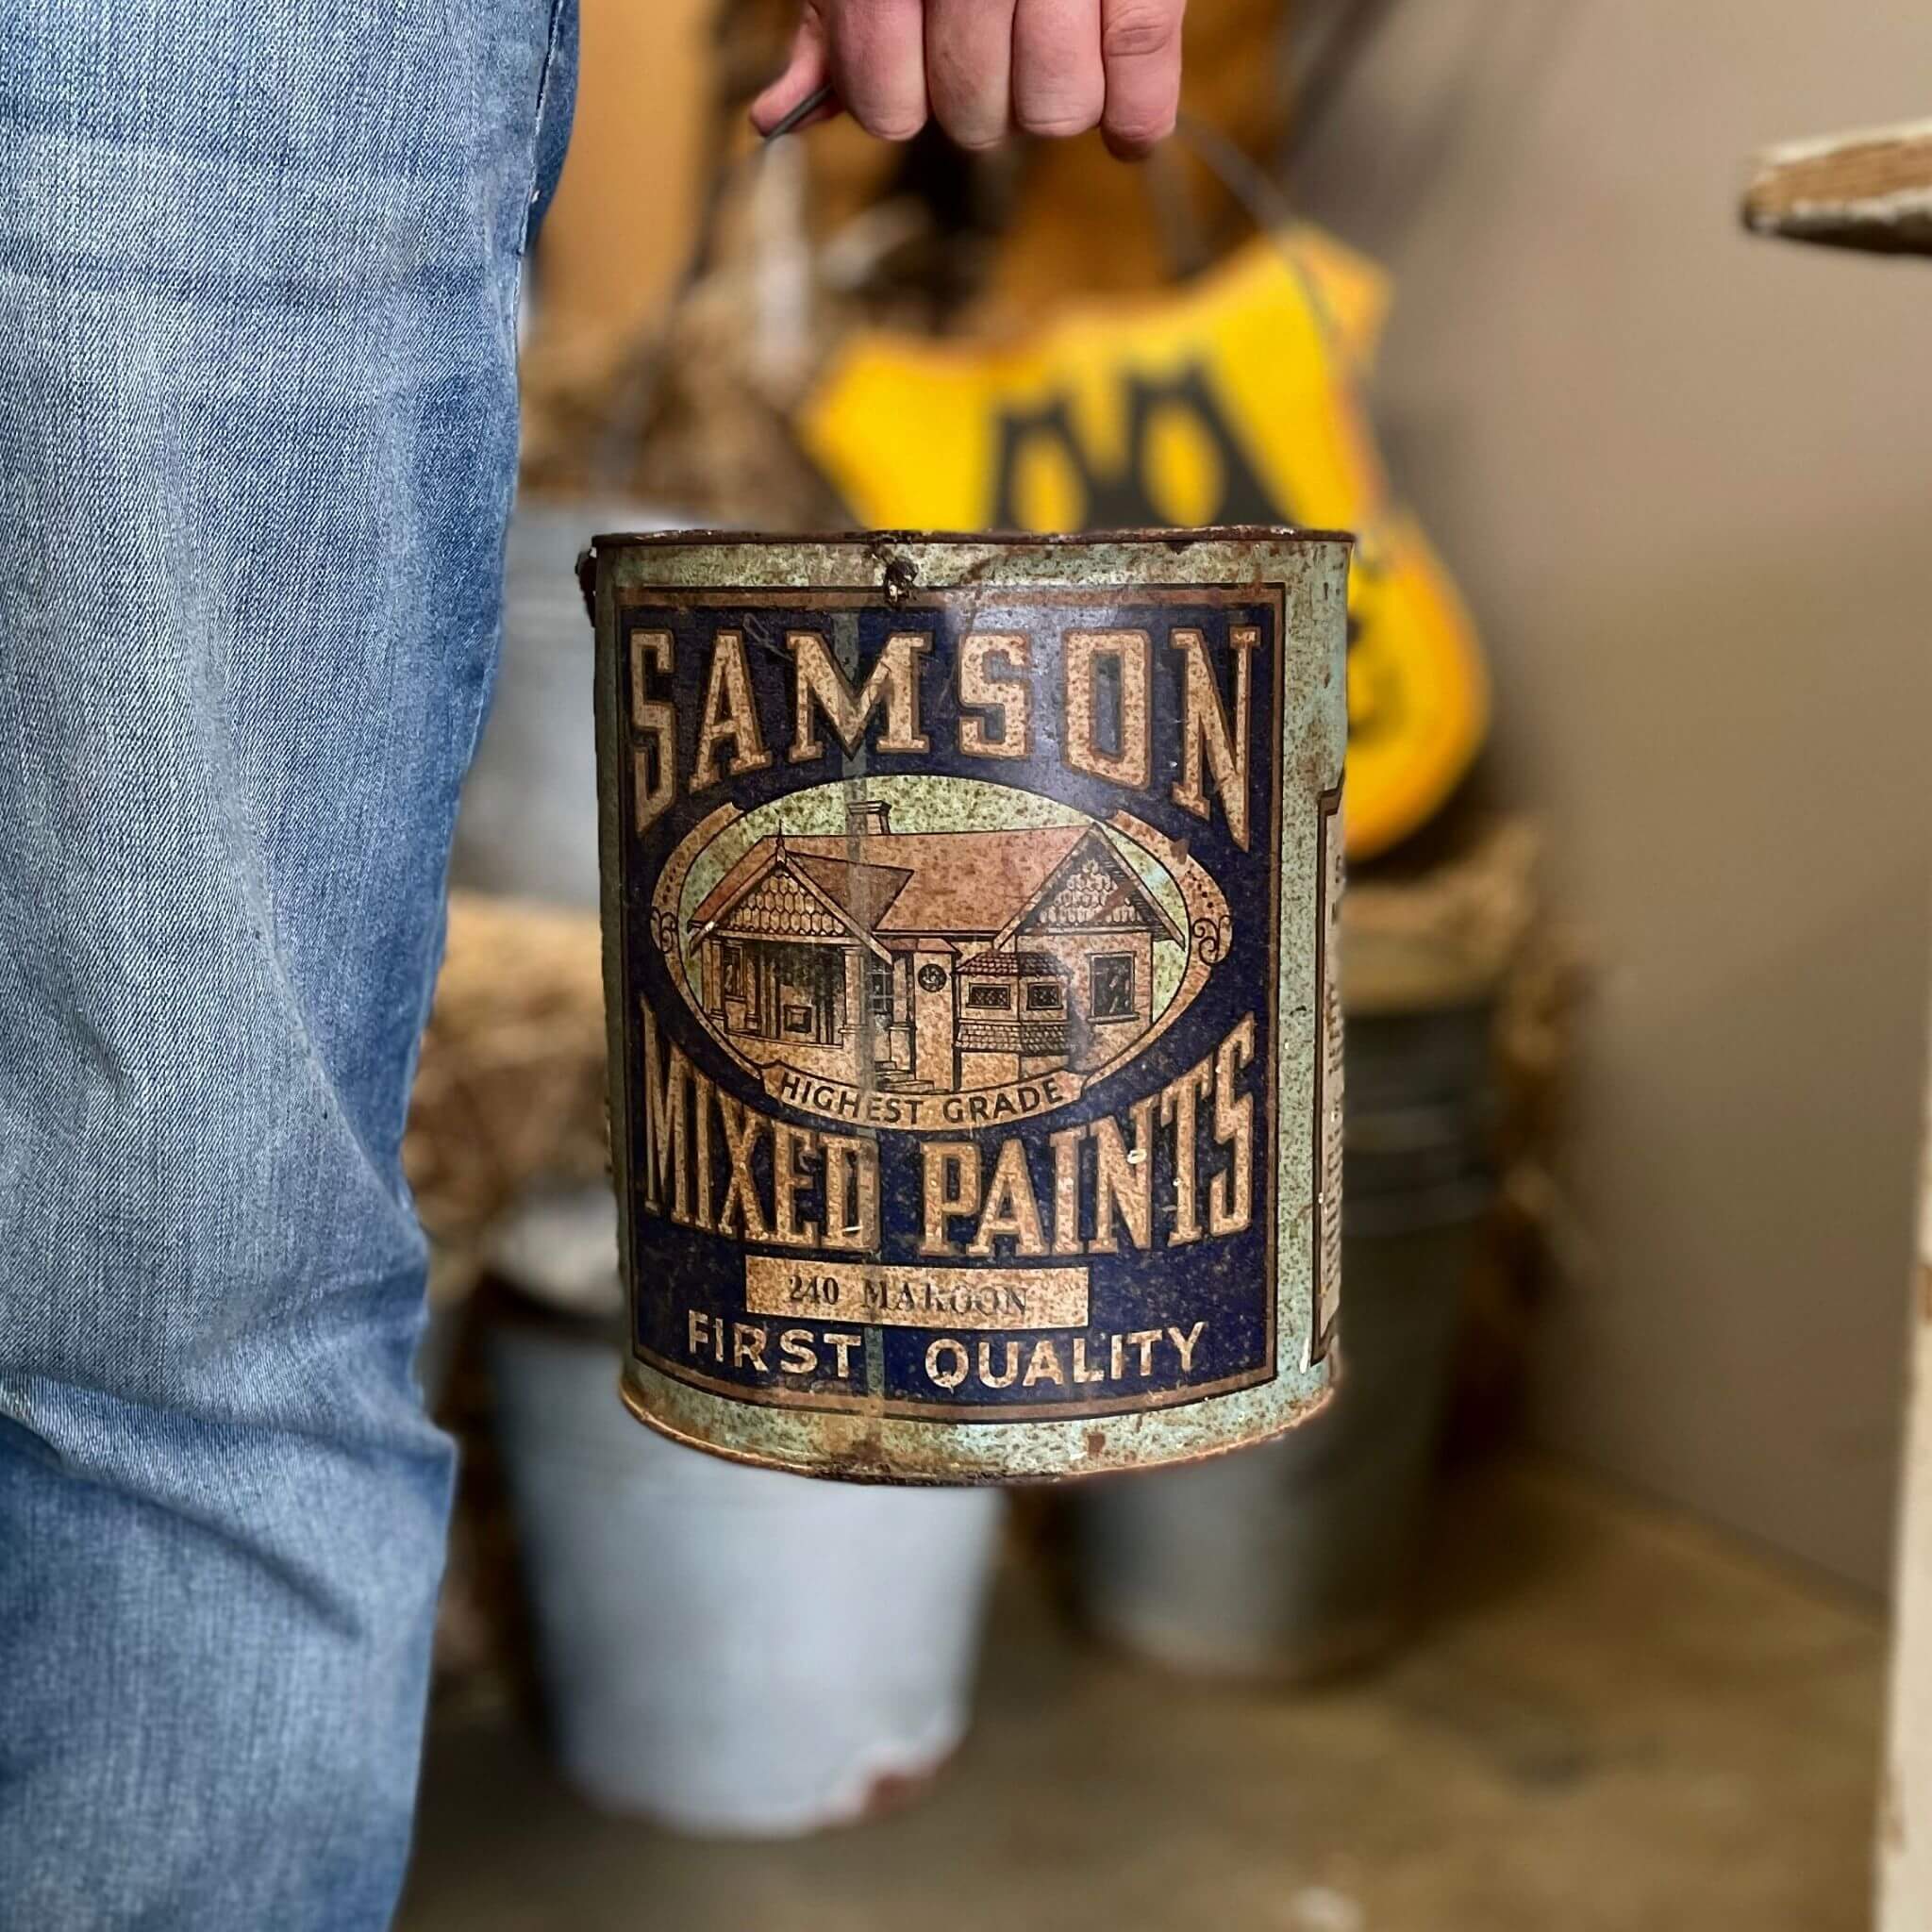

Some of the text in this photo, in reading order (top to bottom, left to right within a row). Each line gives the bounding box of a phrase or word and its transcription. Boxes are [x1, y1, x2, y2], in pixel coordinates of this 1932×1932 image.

[631, 626, 1258, 852] SAMSON
[640, 993, 880, 1253] MIXED
[920, 1011, 1255, 1257] PAINTS
[780, 1072, 1065, 1125] HIGHEST GRADE
[789, 1275, 1028, 1313] 240 MAROON
[687, 1308, 1208, 1391] FIRST QUALITY
